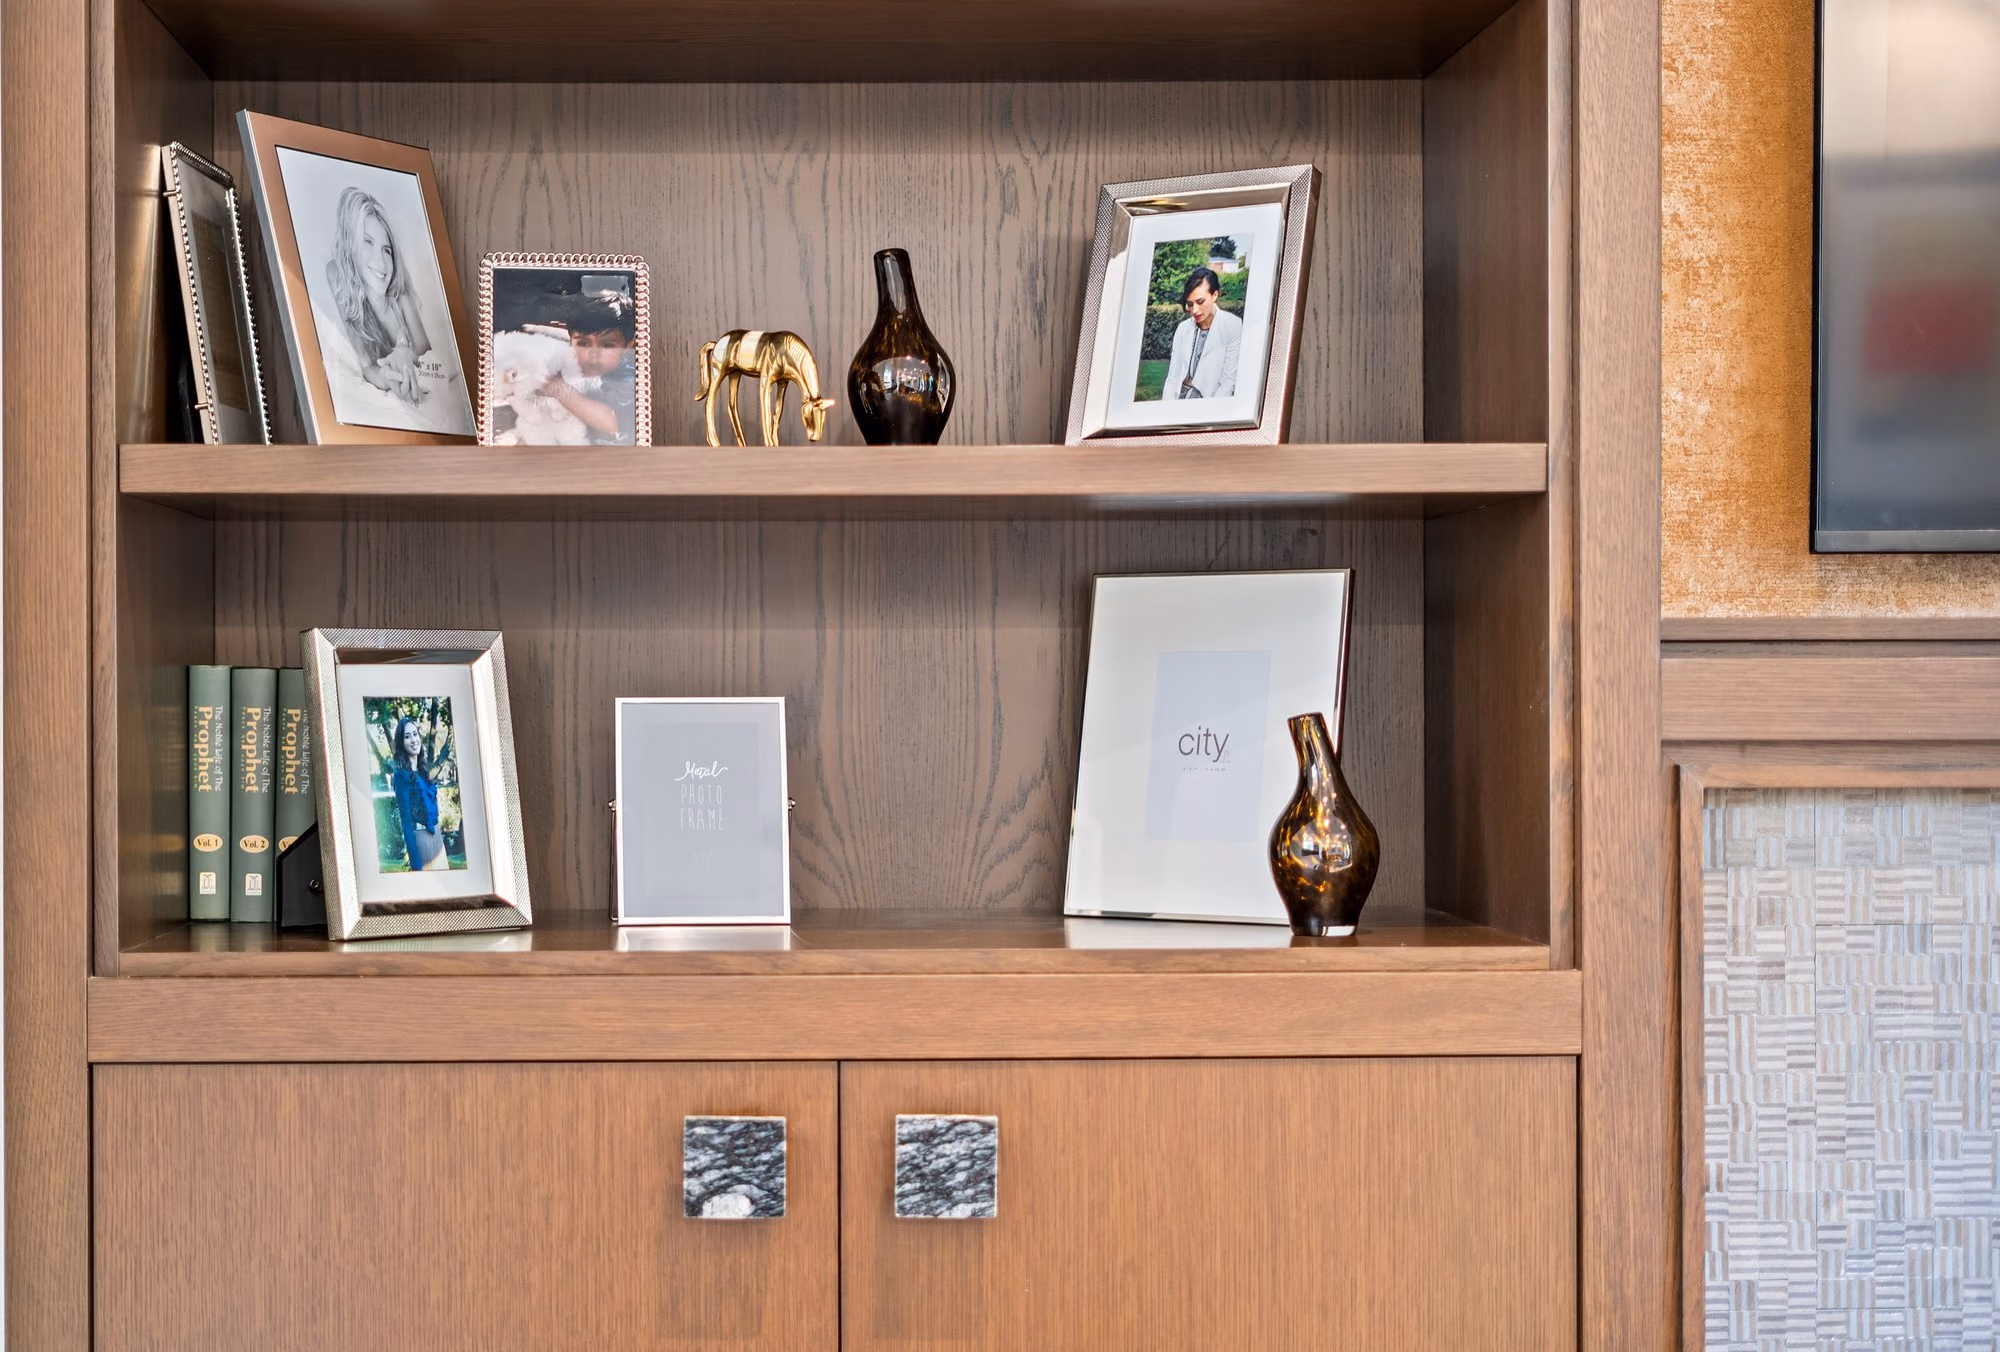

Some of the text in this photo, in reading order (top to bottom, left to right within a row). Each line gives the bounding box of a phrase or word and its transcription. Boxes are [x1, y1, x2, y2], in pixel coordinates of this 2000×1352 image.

[193, 706, 214, 792] Prophet
[213, 706, 224, 792] The Noble Life of The
[241, 707, 262, 793] Prophet
[261, 706, 272, 793] The Noble Life of The
[281, 708, 302, 795] Prophet
[1178, 725, 1230, 763] city
[300, 751, 310, 767] Life
[673, 760, 728, 781] Metal
[300, 768, 310, 777] of
[300, 778, 310, 795] The
[681, 783, 723, 805] PHOTO
[680, 807, 724, 831] FRAME
[196, 839, 212, 848] Vol.
[243, 840, 266, 849] Vol. 2
